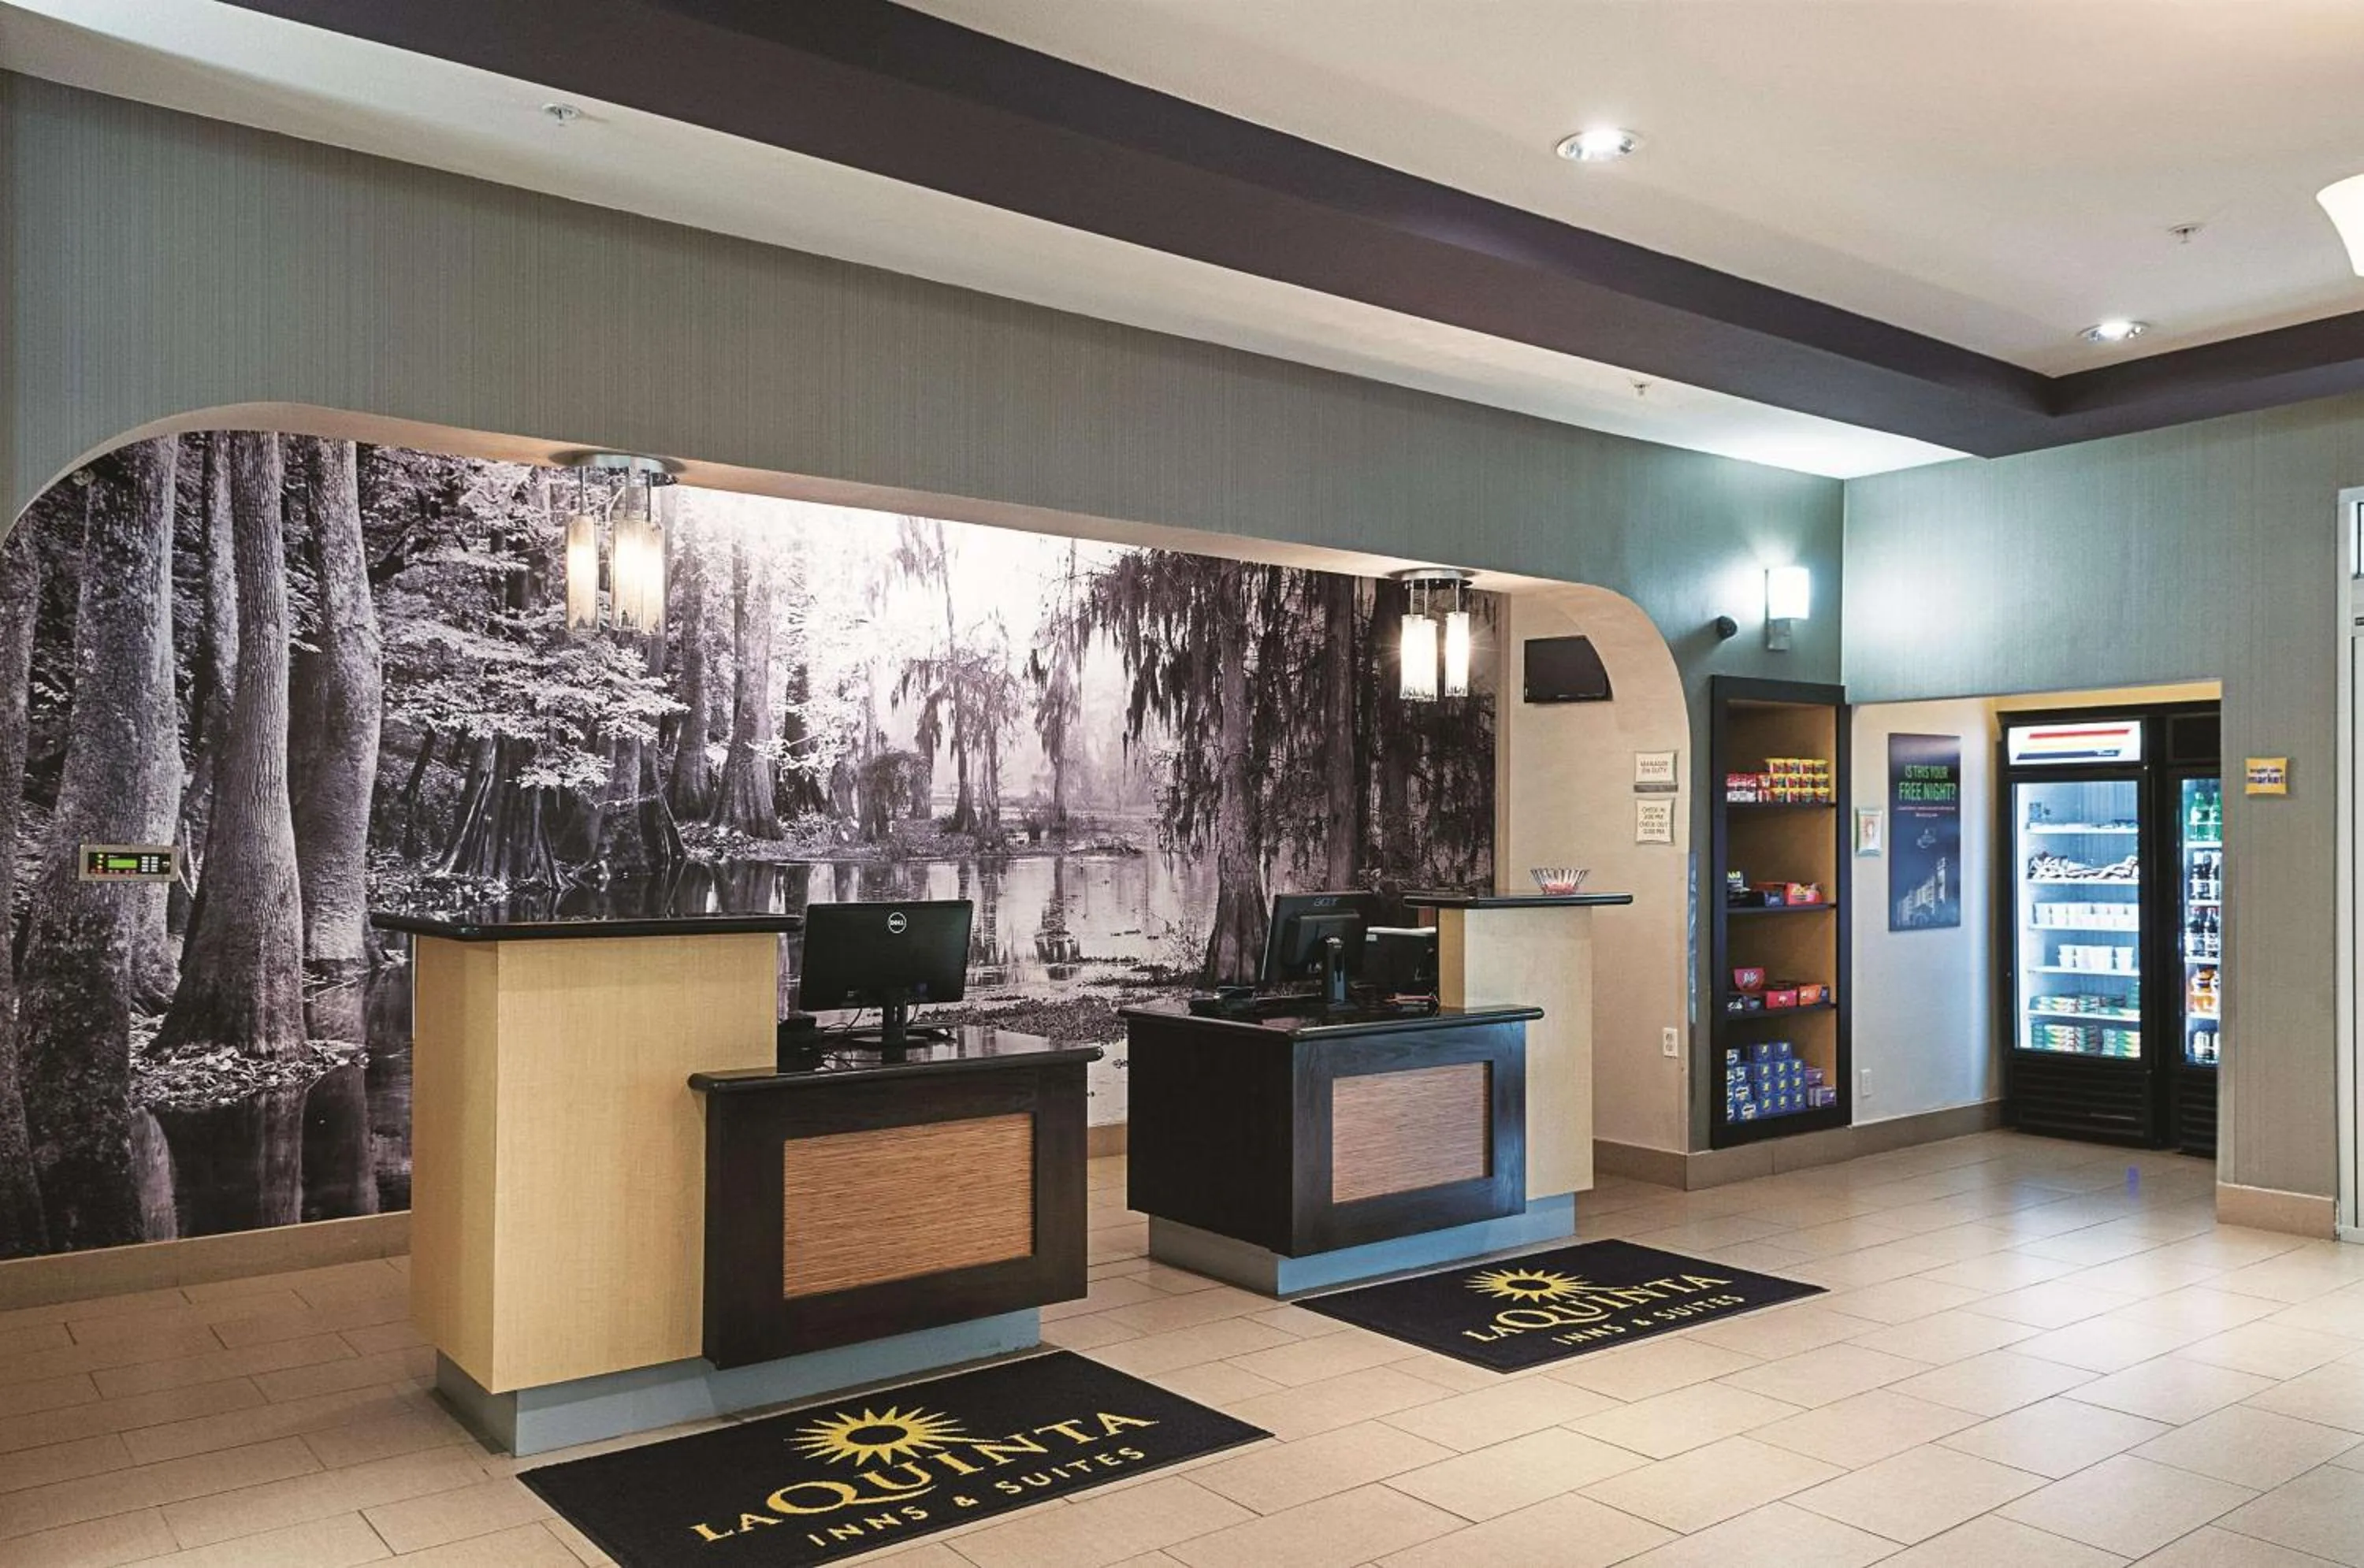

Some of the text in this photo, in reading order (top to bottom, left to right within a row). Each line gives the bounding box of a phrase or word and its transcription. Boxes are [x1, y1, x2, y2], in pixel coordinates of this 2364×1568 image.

[1898, 781, 1957, 801] FREE NIGHT?
[2247, 774, 2283, 784] market
[1551, 1324, 1626, 1345] INNS
[1652, 1295, 1745, 1321] SUITES
[806, 1447, 1145, 1548] INNS & SUITES
